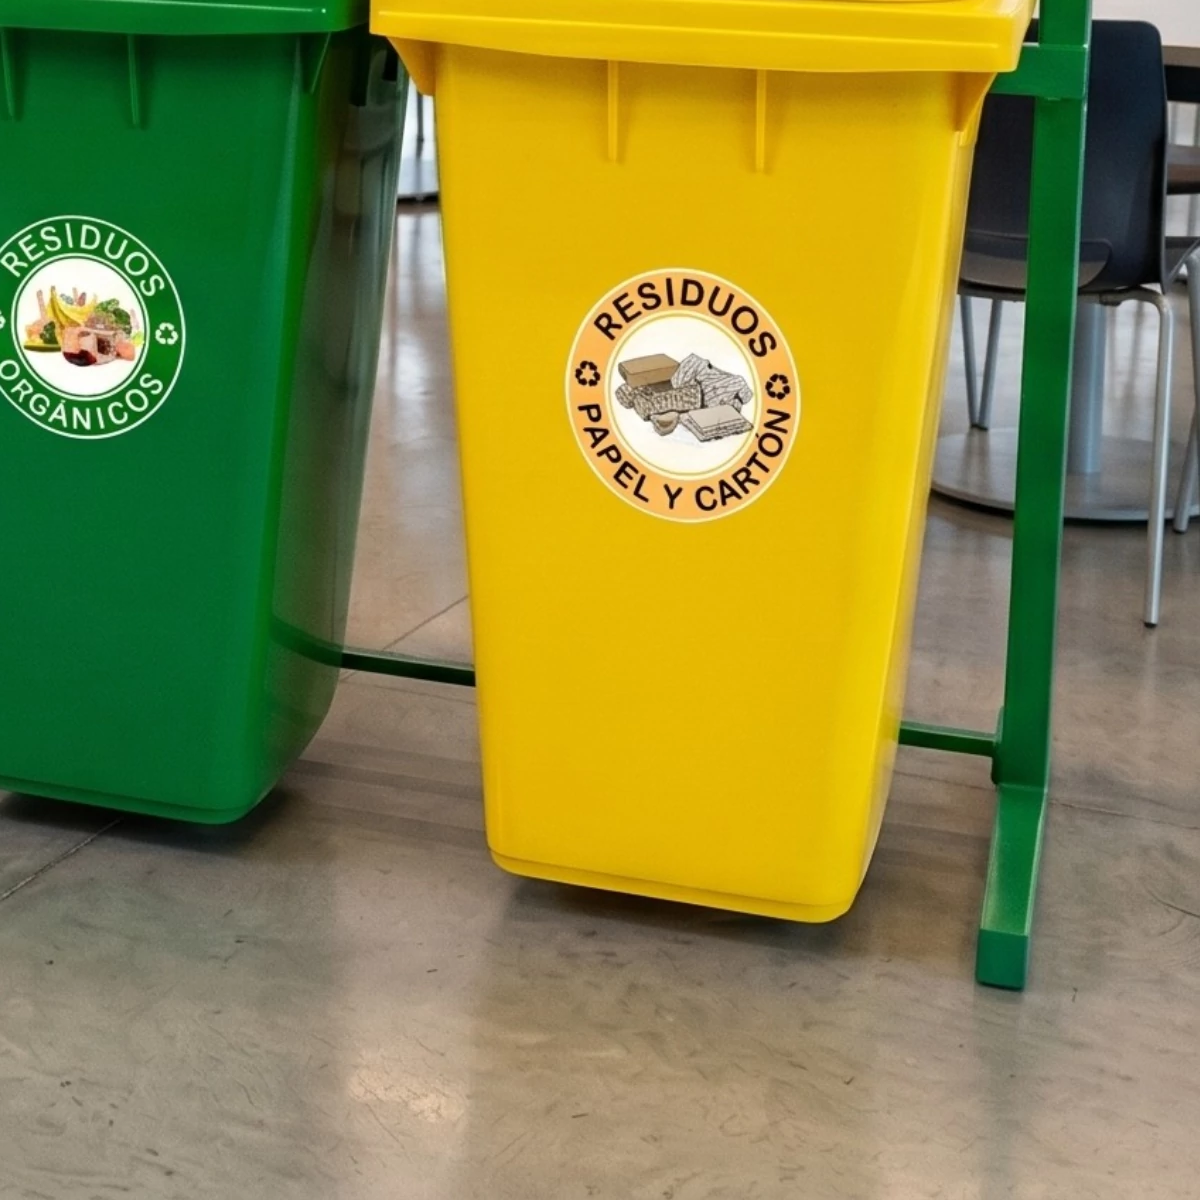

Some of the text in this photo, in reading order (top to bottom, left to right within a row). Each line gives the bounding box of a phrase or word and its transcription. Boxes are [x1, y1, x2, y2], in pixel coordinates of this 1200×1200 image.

[0, 222, 165, 297] RESIDUOS
[593, 277, 777, 357] RESIDUOS
[578, 403, 791, 512] PAPEL Y CARTÓN
